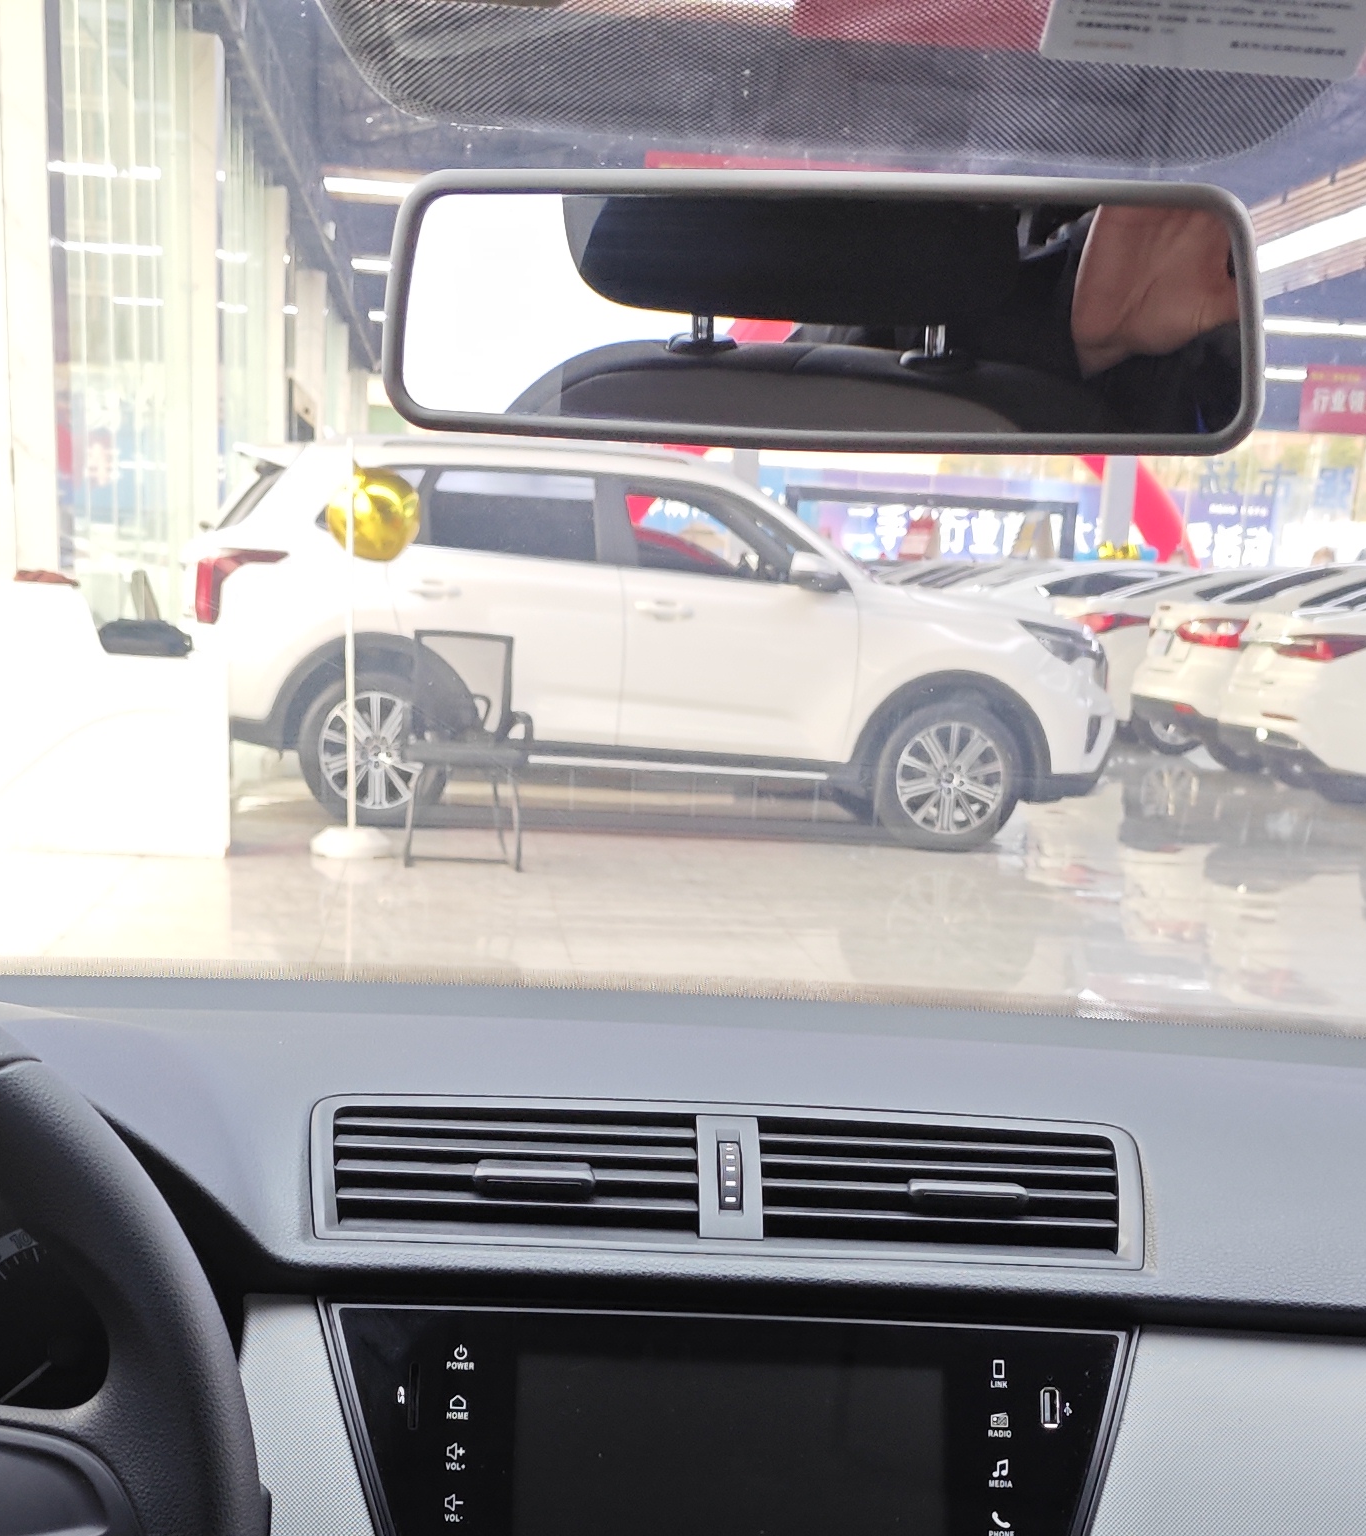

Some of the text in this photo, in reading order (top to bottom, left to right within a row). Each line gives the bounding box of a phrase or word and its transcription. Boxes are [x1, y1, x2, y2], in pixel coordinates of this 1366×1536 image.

[446, 1361, 475, 1370] POWER
[990, 1380, 1008, 1388] LINK
[446, 1411, 469, 1420] HOME
[988, 1429, 1012, 1438] RADIO
[445, 1462, 466, 1471] VOL+
[988, 1479, 1013, 1488] MEDIA
